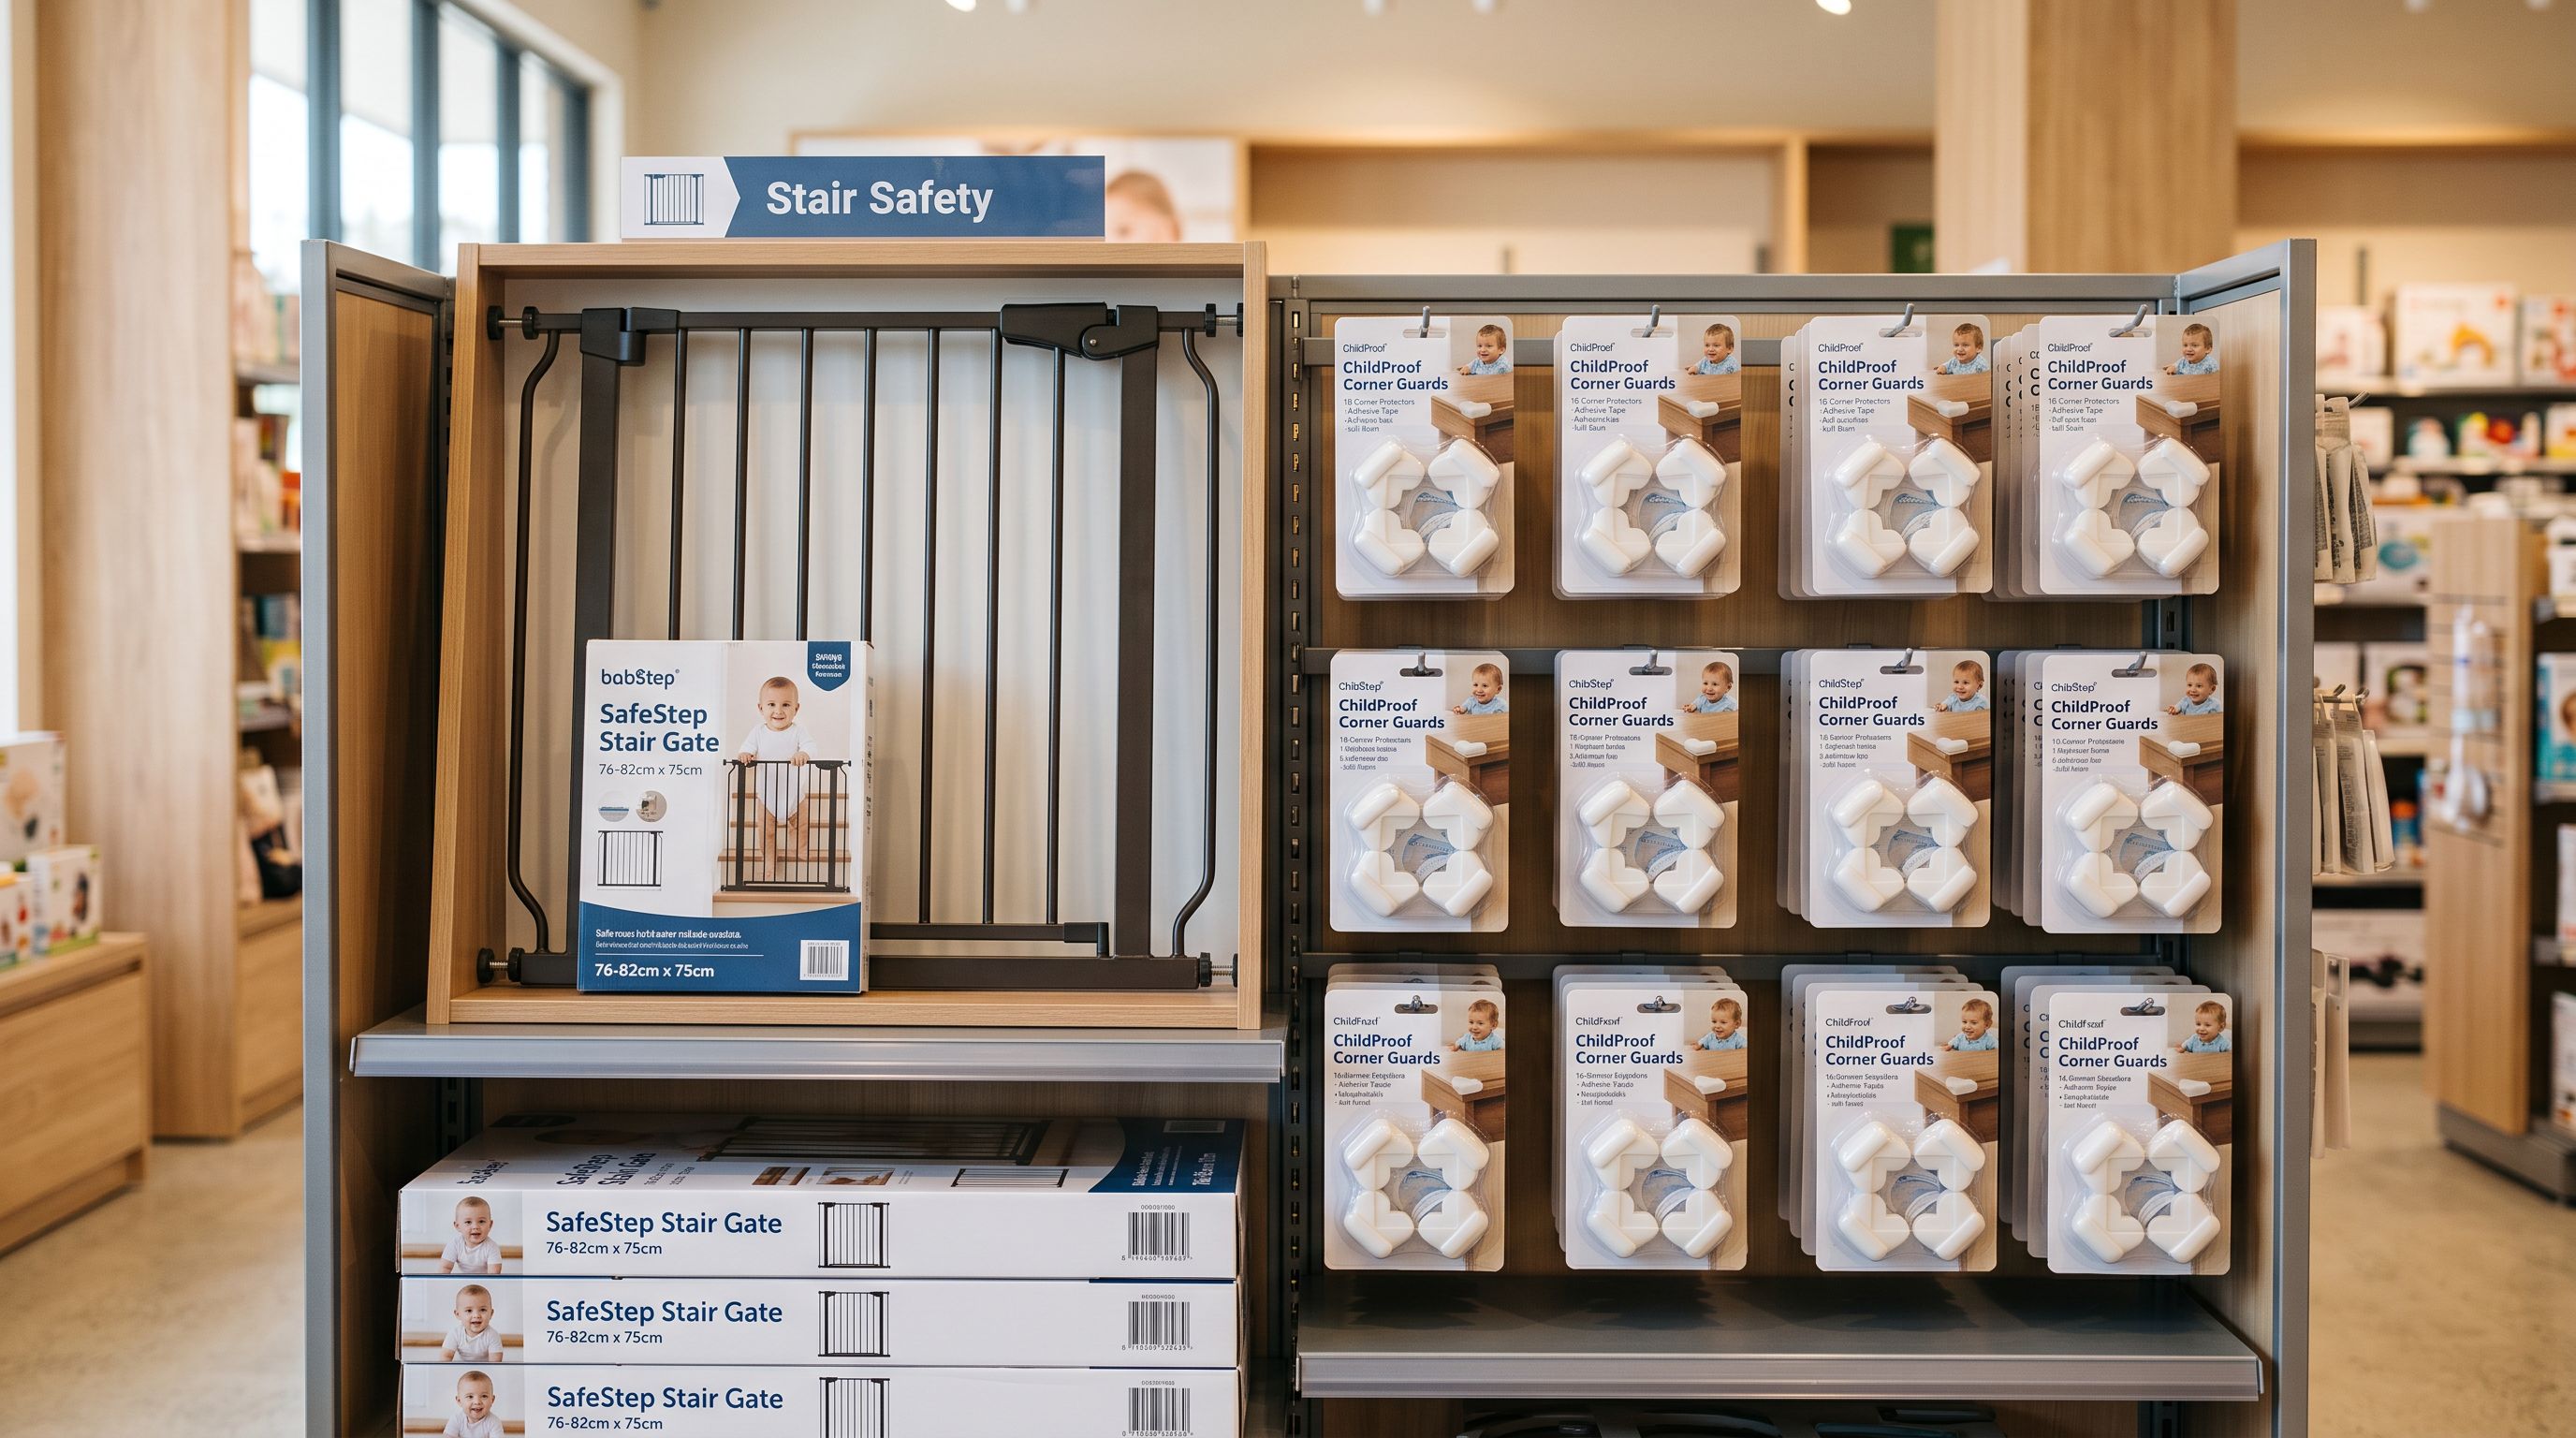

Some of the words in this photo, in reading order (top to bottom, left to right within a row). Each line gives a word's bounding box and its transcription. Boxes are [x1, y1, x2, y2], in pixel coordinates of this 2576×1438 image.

[767, 181, 856, 214] Stair
[870, 180, 993, 223] Safety
[1343, 360, 1421, 374] ChildProof
[1571, 360, 1648, 373] ChildProof
[1819, 360, 1896, 374] ChildProof
[2048, 360, 2127, 373] ChildProof
[1344, 378, 1393, 390] Corner
[1398, 376, 1448, 389] Guards
[1571, 377, 1620, 389] Corner
[1624, 376, 1676, 389] Guards
[1819, 378, 1868, 390] Corner
[1872, 376, 1924, 389] Guards
[2048, 378, 2098, 389] Corner
[2101, 376, 2153, 389] Guards
[1382, 407, 1398, 416] Tape
[1609, 406, 1625, 415] Tape
[2086, 406, 2103, 415] Tape
[1339, 699, 1417, 712] ChildProof
[1570, 697, 1647, 709] ChildProof
[1820, 697, 1897, 709] ChildProof
[2052, 700, 2130, 712] ChildProof
[600, 703, 707, 729] SafeStep
[1339, 716, 1389, 727] Corner
[1393, 716, 1444, 728] Guards
[1569, 714, 1618, 726] Corner
[1622, 714, 1674, 726] Guards
[1819, 714, 1868, 726] Corner
[1873, 713, 1925, 726] Guards
[2052, 718, 2101, 729] Corner
[2106, 717, 2158, 729] Guards
[600, 731, 656, 751] Stair
[663, 732, 719, 752] Gate
[599, 764, 654, 774] 76-82cm
[669, 765, 702, 775] 75cm
[595, 963, 659, 976] 76-82cm
[663, 967, 671, 976] x
[675, 964, 714, 976] 75cm
[1334, 1034, 1412, 1047] ChildProof
[1576, 1034, 1655, 1047] ChildProof
[1826, 1035, 1906, 1049] ChildProof
[2059, 1037, 2139, 1050] ChildProof
[1334, 1051, 1383, 1064] Corner
[1388, 1051, 1440, 1064] Guards
[1576, 1051, 1626, 1064] Corner
[1631, 1051, 1683, 1064] Guards
[1826, 1053, 1876, 1065] Corner
[1881, 1052, 1934, 1064] Guards
[2059, 1054, 2110, 1067] Corner
[2115, 1054, 2167, 1067] Guards
[547, 1211, 653, 1238] SafeStep
[662, 1212, 717, 1233] Stair
[724, 1212, 782, 1233] Gate
[547, 1242, 607, 1254] 76-82cm
[613, 1245, 620, 1254] x
[624, 1242, 662, 1254] 75cm
[548, 1300, 654, 1327] SafeStep
[663, 1301, 718, 1322] Stair
[724, 1301, 782, 1322] Gate
[547, 1331, 608, 1343] 76-82cm
[613, 1334, 620, 1343] x
[624, 1331, 662, 1343] 75cm
[549, 1387, 654, 1413] SafeStep
[663, 1387, 718, 1408] Stair
[725, 1387, 783, 1409] Gate
[548, 1416, 608, 1429] 76-82cm
[625, 1417, 662, 1429] 75cm
